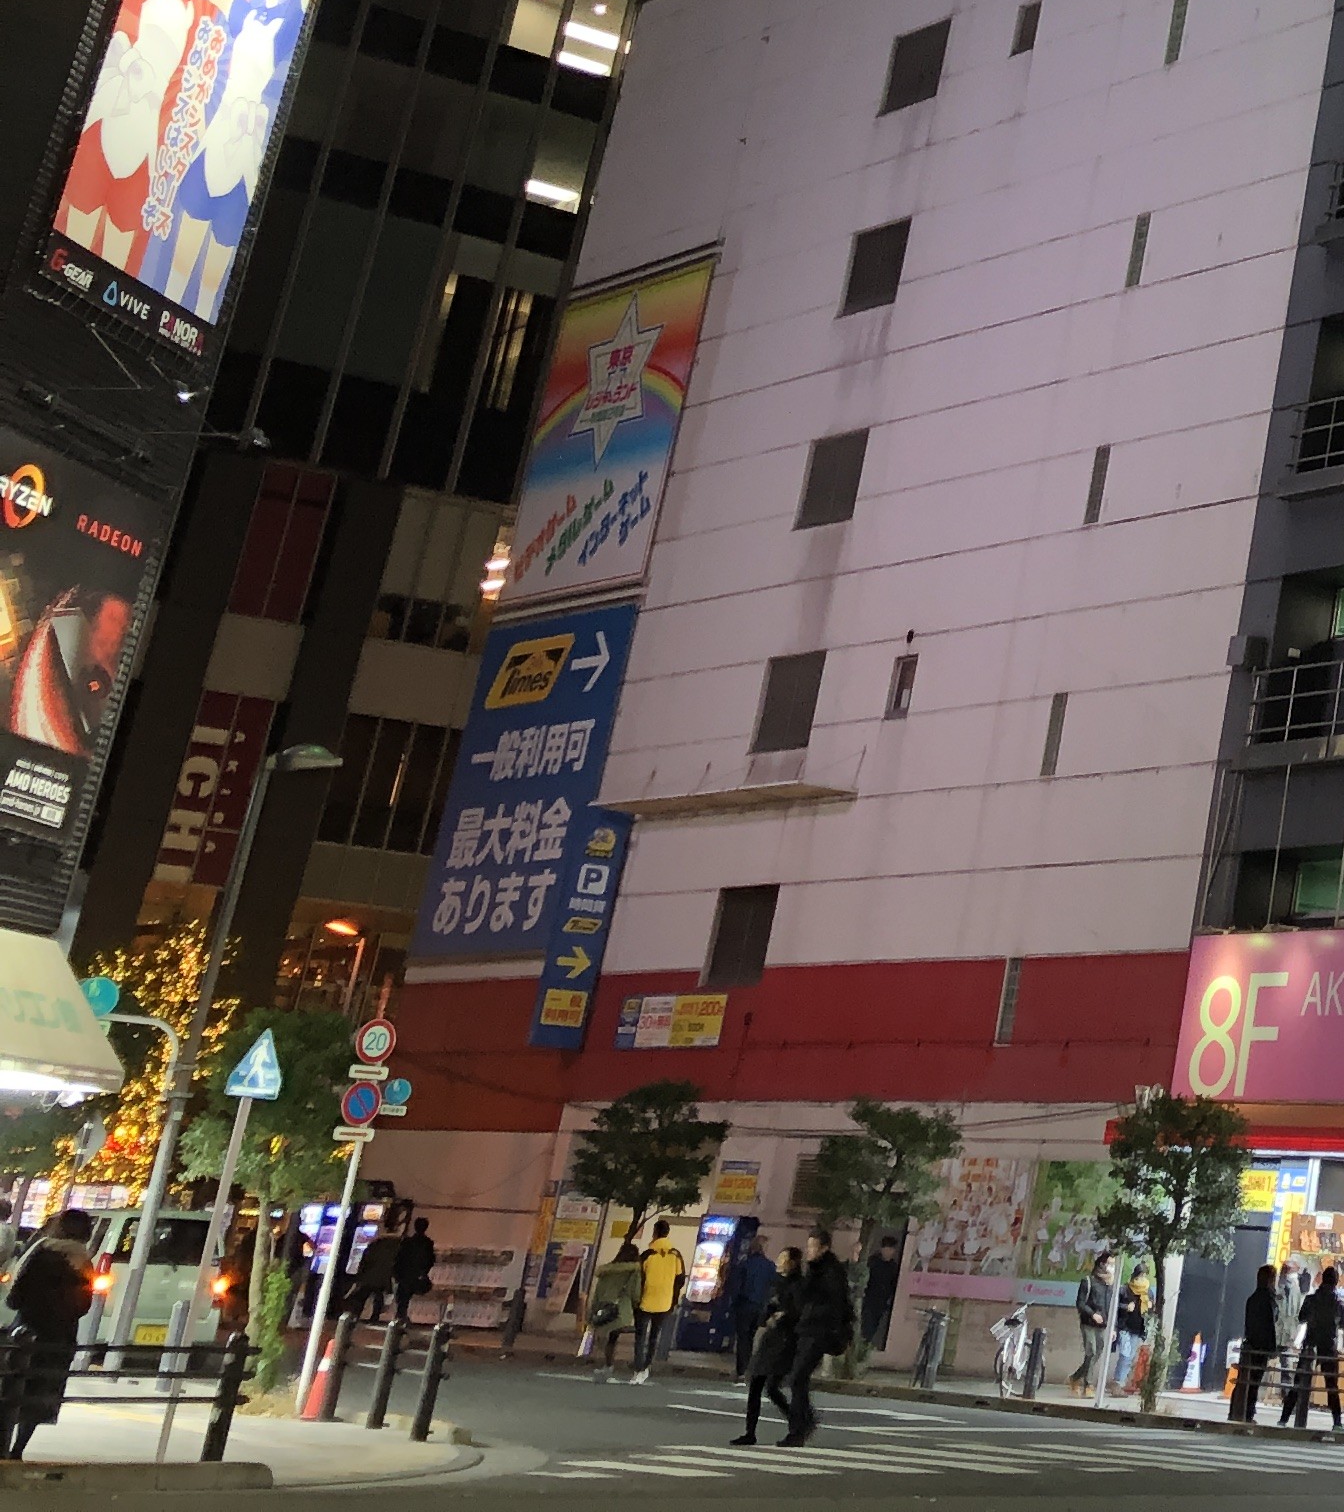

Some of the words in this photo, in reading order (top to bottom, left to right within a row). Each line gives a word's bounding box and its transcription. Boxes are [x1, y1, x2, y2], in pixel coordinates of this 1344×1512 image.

[120, 290, 151, 320] VIVE
[0, 474, 54, 517] RYZEN
[76, 513, 143, 557] RADEON
[471, 718, 596, 781] 一般利用可
[4, 768, 31, 791] AMD
[28, 776, 72, 804] HEROES
[445, 797, 573, 871] 最大料金
[431, 868, 557, 936] あります
[364, 1031, 388, 1052] 20
[1187, 969, 1289, 1099] 8F
